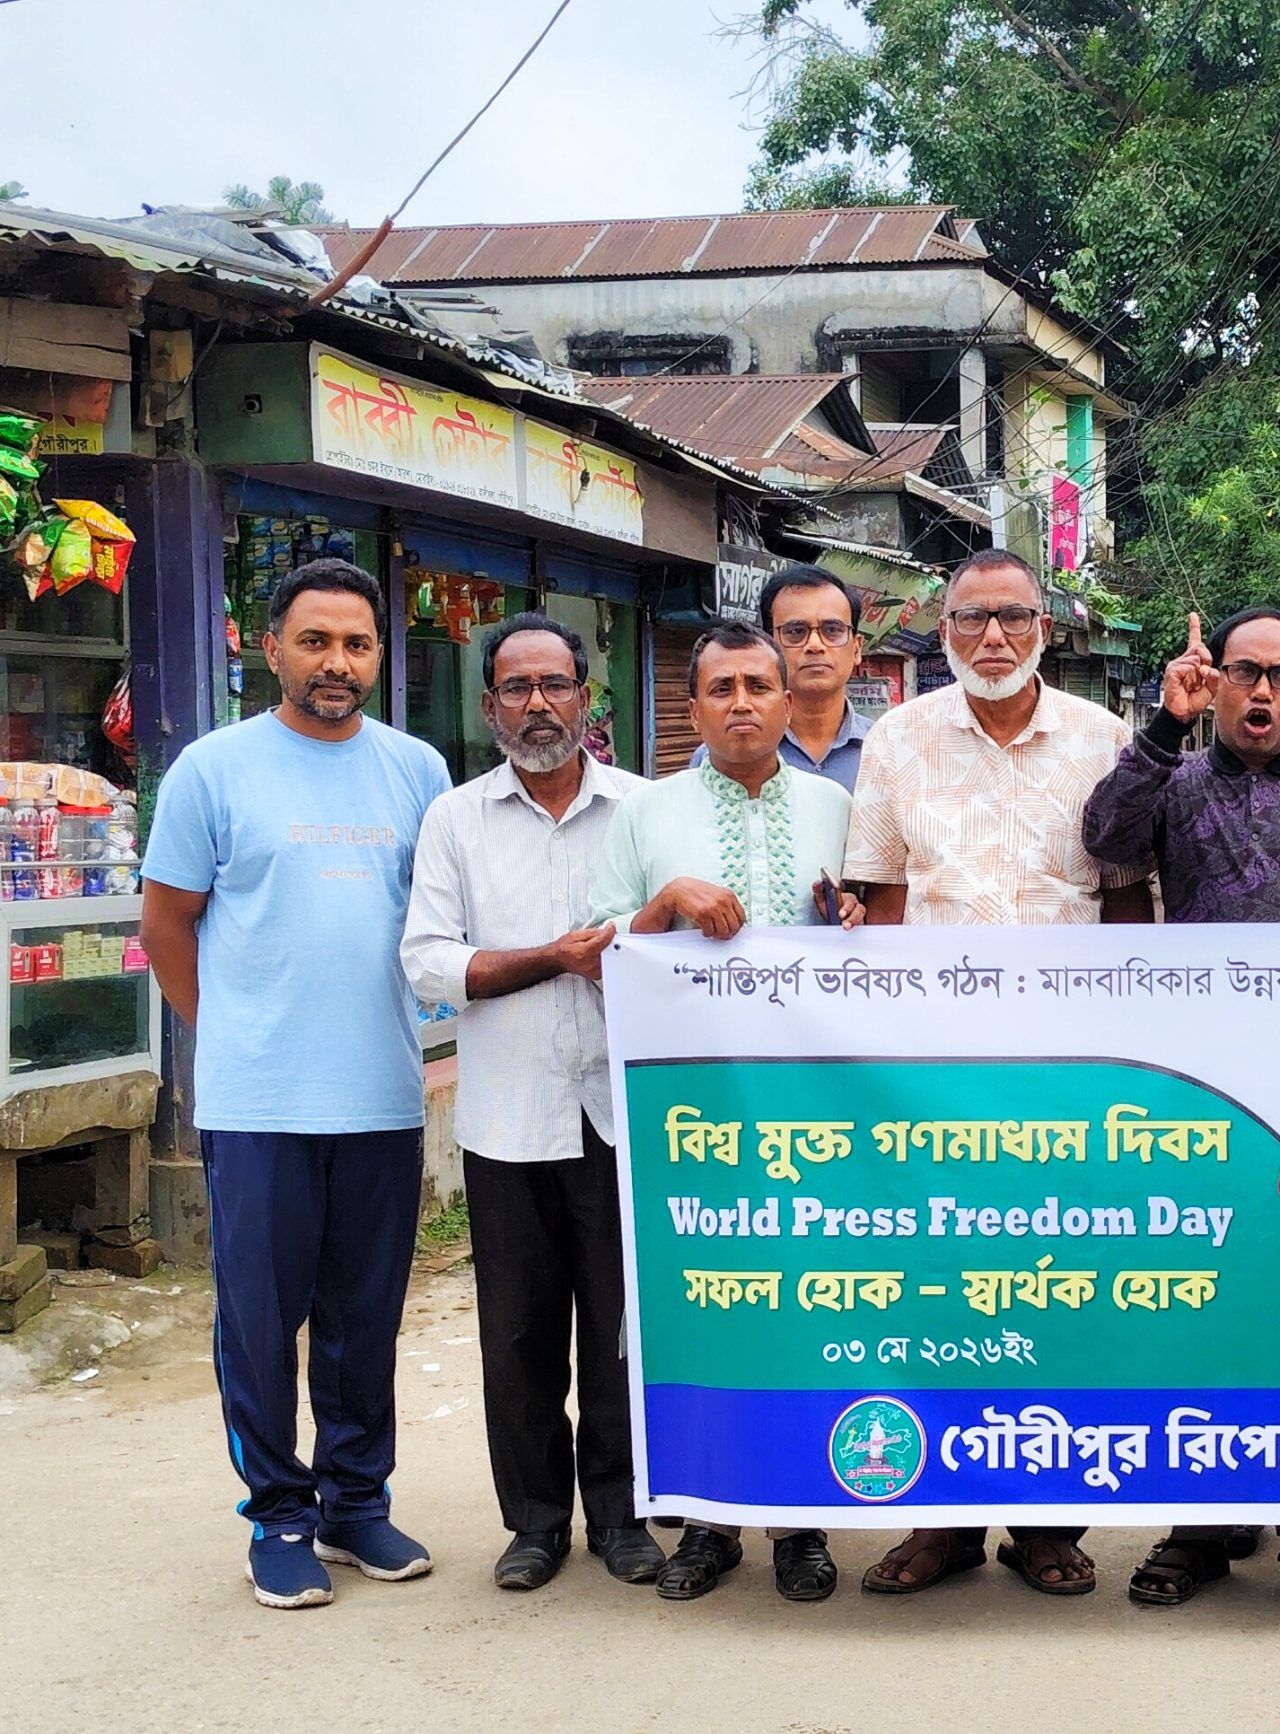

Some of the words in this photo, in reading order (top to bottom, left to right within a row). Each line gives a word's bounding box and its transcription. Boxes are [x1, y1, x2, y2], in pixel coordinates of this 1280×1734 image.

[289, 824, 396, 846] HILFIGER
[814, 958, 925, 997] ভবিষ্যৎ
[938, 955, 1003, 997] গঠন
[1039, 958, 1214, 996] মানবাধিকার
[666, 1106, 741, 1165] বিশ্ব
[757, 1122, 853, 1182] মুক্ত
[872, 1121, 1088, 1162] গণমাধ্যম
[1104, 1105, 1230, 1162] দিবস
[668, 1198, 780, 1236] World
[793, 1198, 916, 1236] Press
[929, 1198, 1135, 1235] Freedom
[1149, 1198, 1232, 1245] Day
[684, 1270, 781, 1308] সফল
[798, 1272, 903, 1311] হোক
[962, 1255, 1096, 1315] স্বার্থক
[1114, 1272, 1217, 1310] হোক
[823, 1341, 864, 1362] ০৩
[878, 1339, 909, 1362] মে
[941, 1404, 1149, 1491] গৌরীপুর
